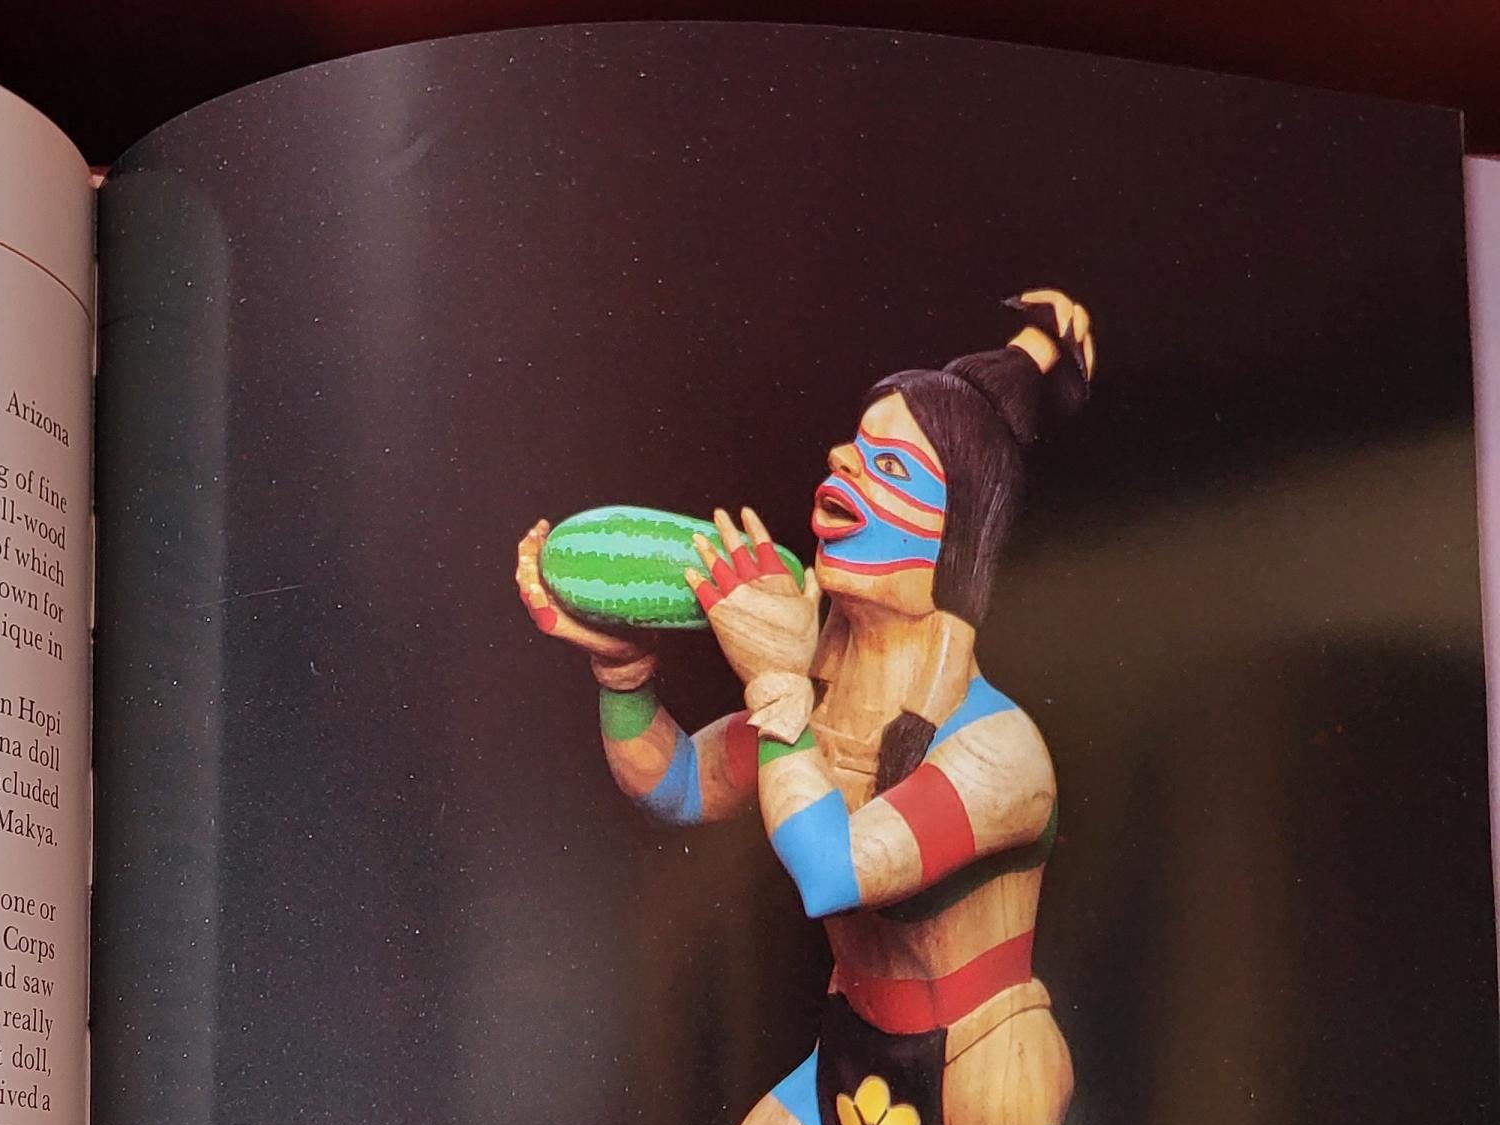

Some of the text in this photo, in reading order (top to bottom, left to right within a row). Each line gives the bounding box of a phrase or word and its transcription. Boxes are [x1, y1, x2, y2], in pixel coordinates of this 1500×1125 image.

[4, 390, 71, 449] Arizona
[15, 469, 37, 495] of
[38, 475, 69, 514] fine
[28, 738, 62, 772] doll
[2, 925, 57, 964] Corps
[11, 1043, 54, 1077] doll,
